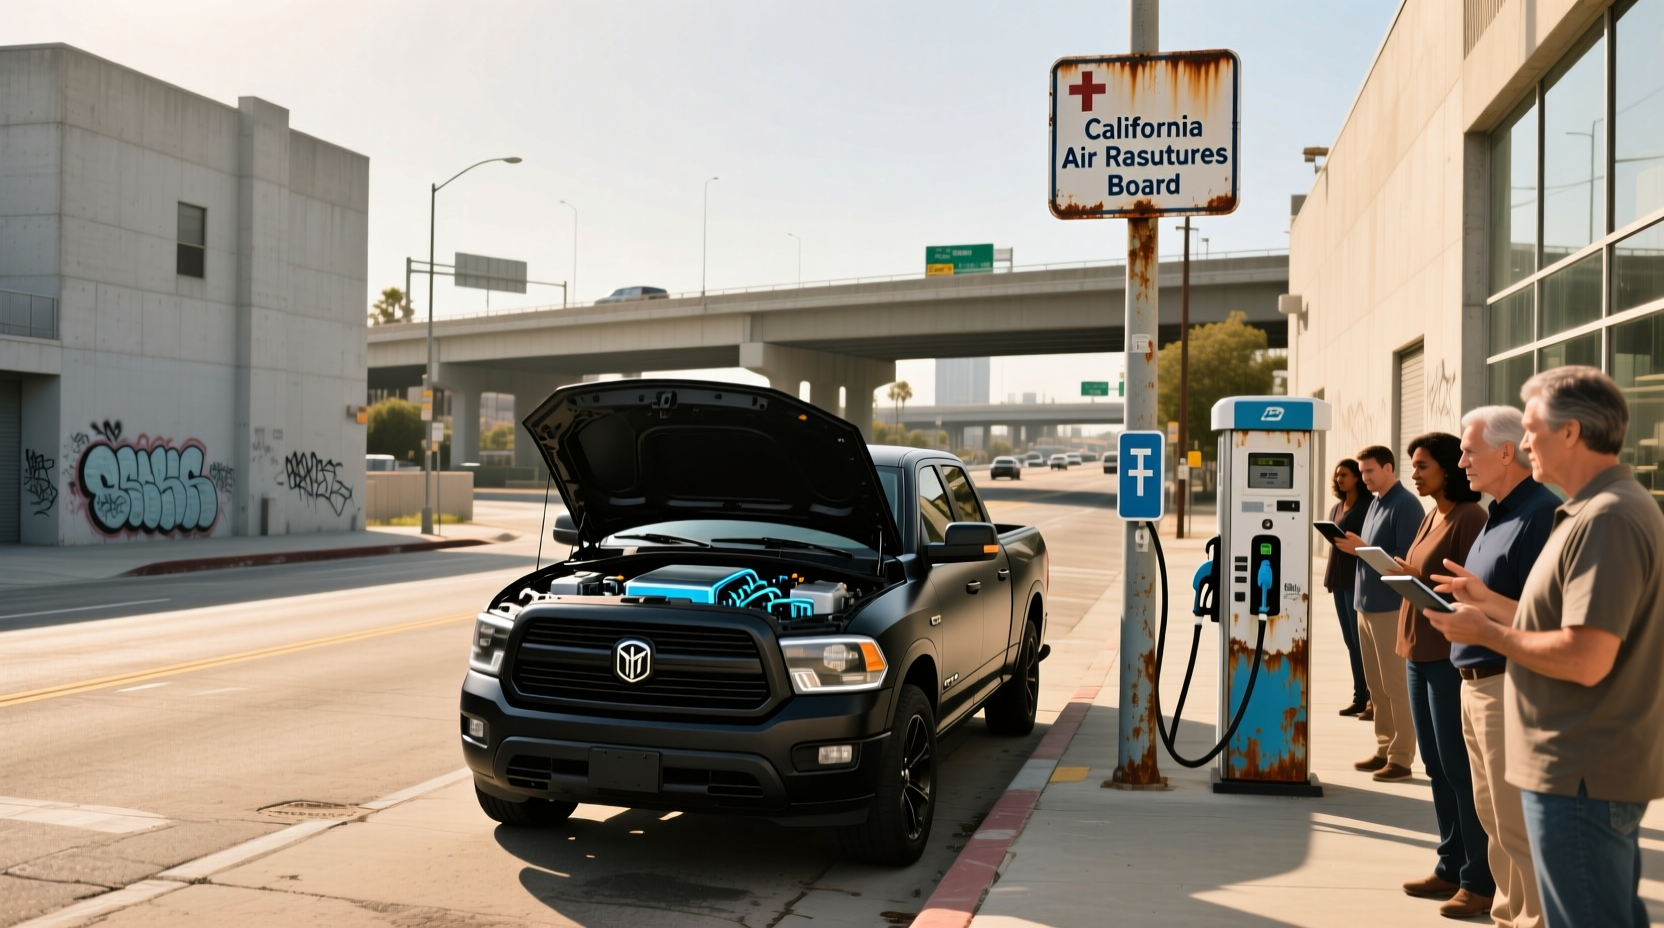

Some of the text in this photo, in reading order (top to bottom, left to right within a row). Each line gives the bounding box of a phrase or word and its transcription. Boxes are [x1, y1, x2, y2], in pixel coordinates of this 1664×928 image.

[1085, 115, 1203, 140] California
[1061, 145, 1228, 169] Air Rasutures
[1107, 173, 1180, 196] Board
